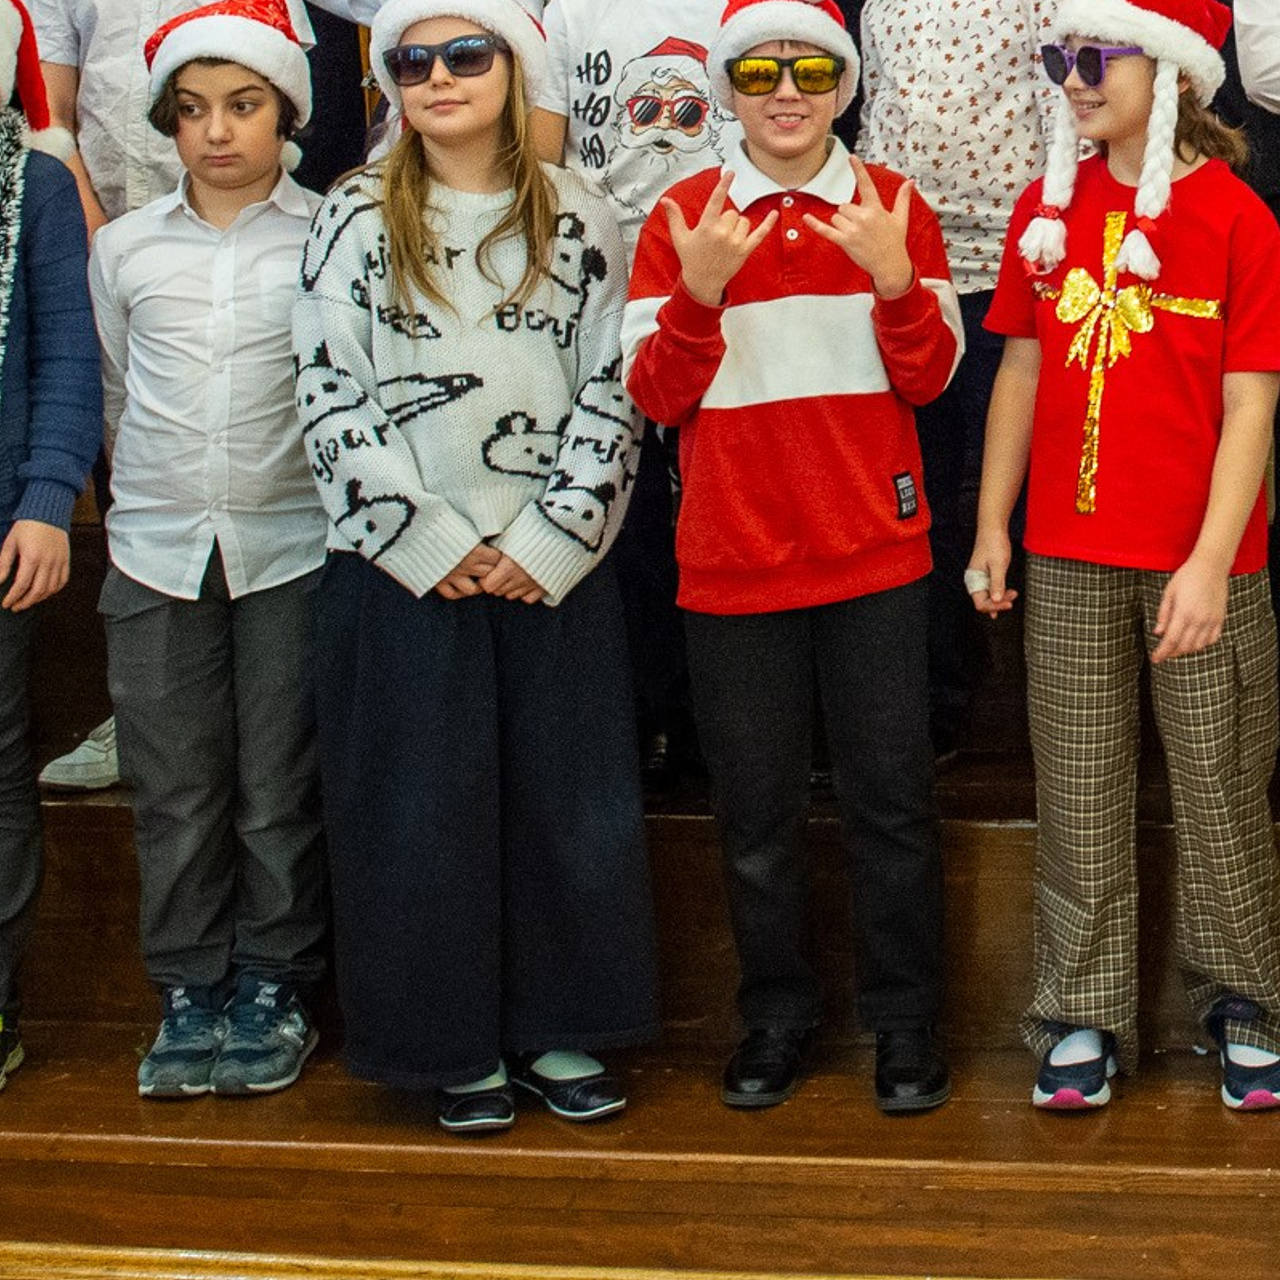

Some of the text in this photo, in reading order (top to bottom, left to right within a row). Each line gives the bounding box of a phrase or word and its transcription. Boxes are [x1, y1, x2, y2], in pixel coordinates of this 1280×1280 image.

[576, 49, 612, 86] HO
[572, 92, 611, 127] HO
[580, 133, 606, 169] HO
